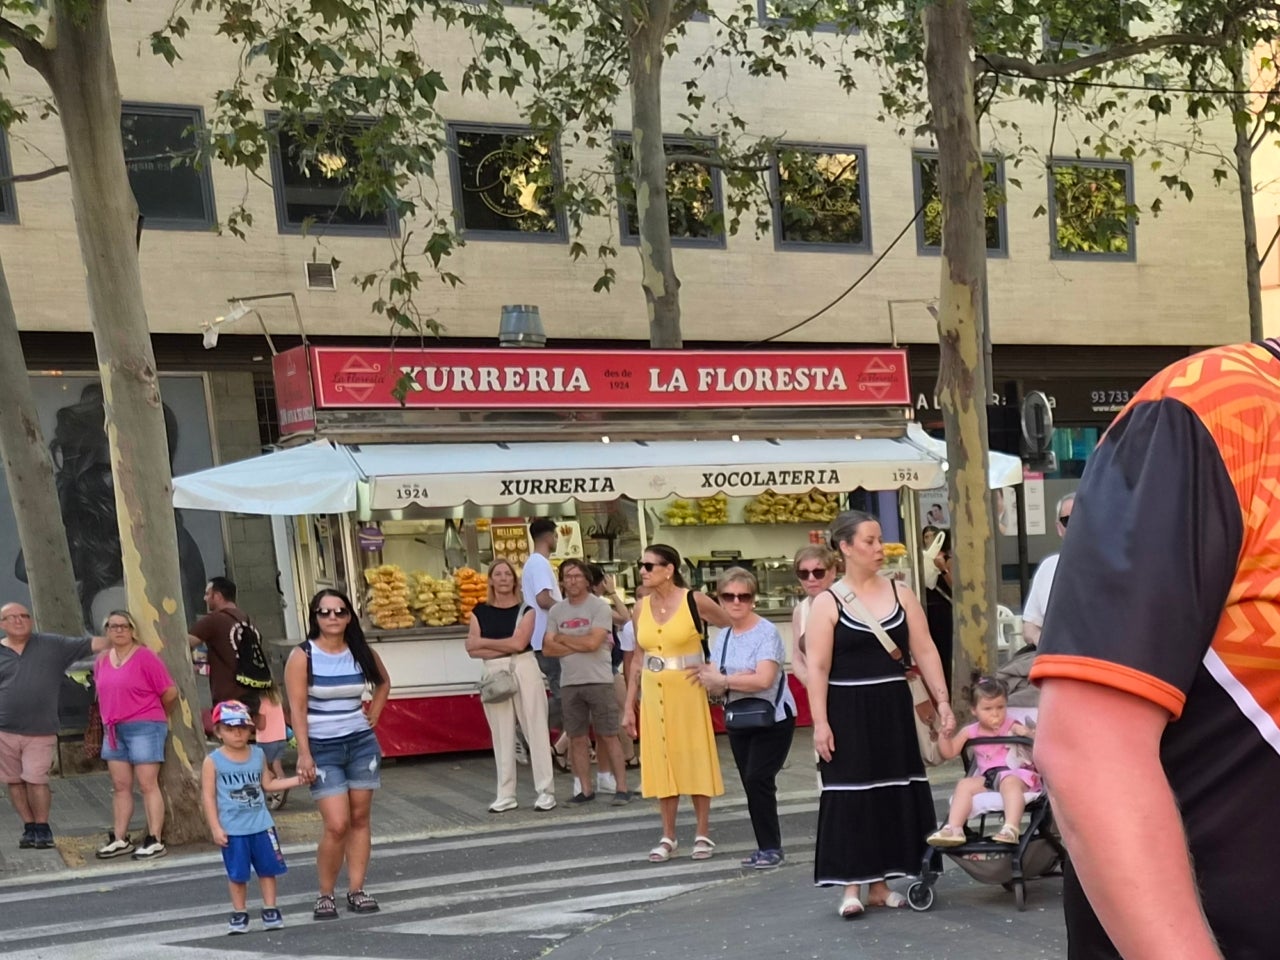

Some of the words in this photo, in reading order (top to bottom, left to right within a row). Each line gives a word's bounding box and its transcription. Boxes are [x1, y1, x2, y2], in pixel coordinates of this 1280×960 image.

[399, 366, 592, 393] XURRERIA
[649, 367, 688, 392] LA
[697, 367, 848, 391] FLORESTA
[1091, 391, 1106, 403] 93
[1108, 391, 1129, 403] 733
[500, 475, 615, 497] XURRERIA
[701, 468, 841, 489] XOCOLATERIA
[892, 471, 919, 482] 1924
[396, 488, 429, 500] 1924
